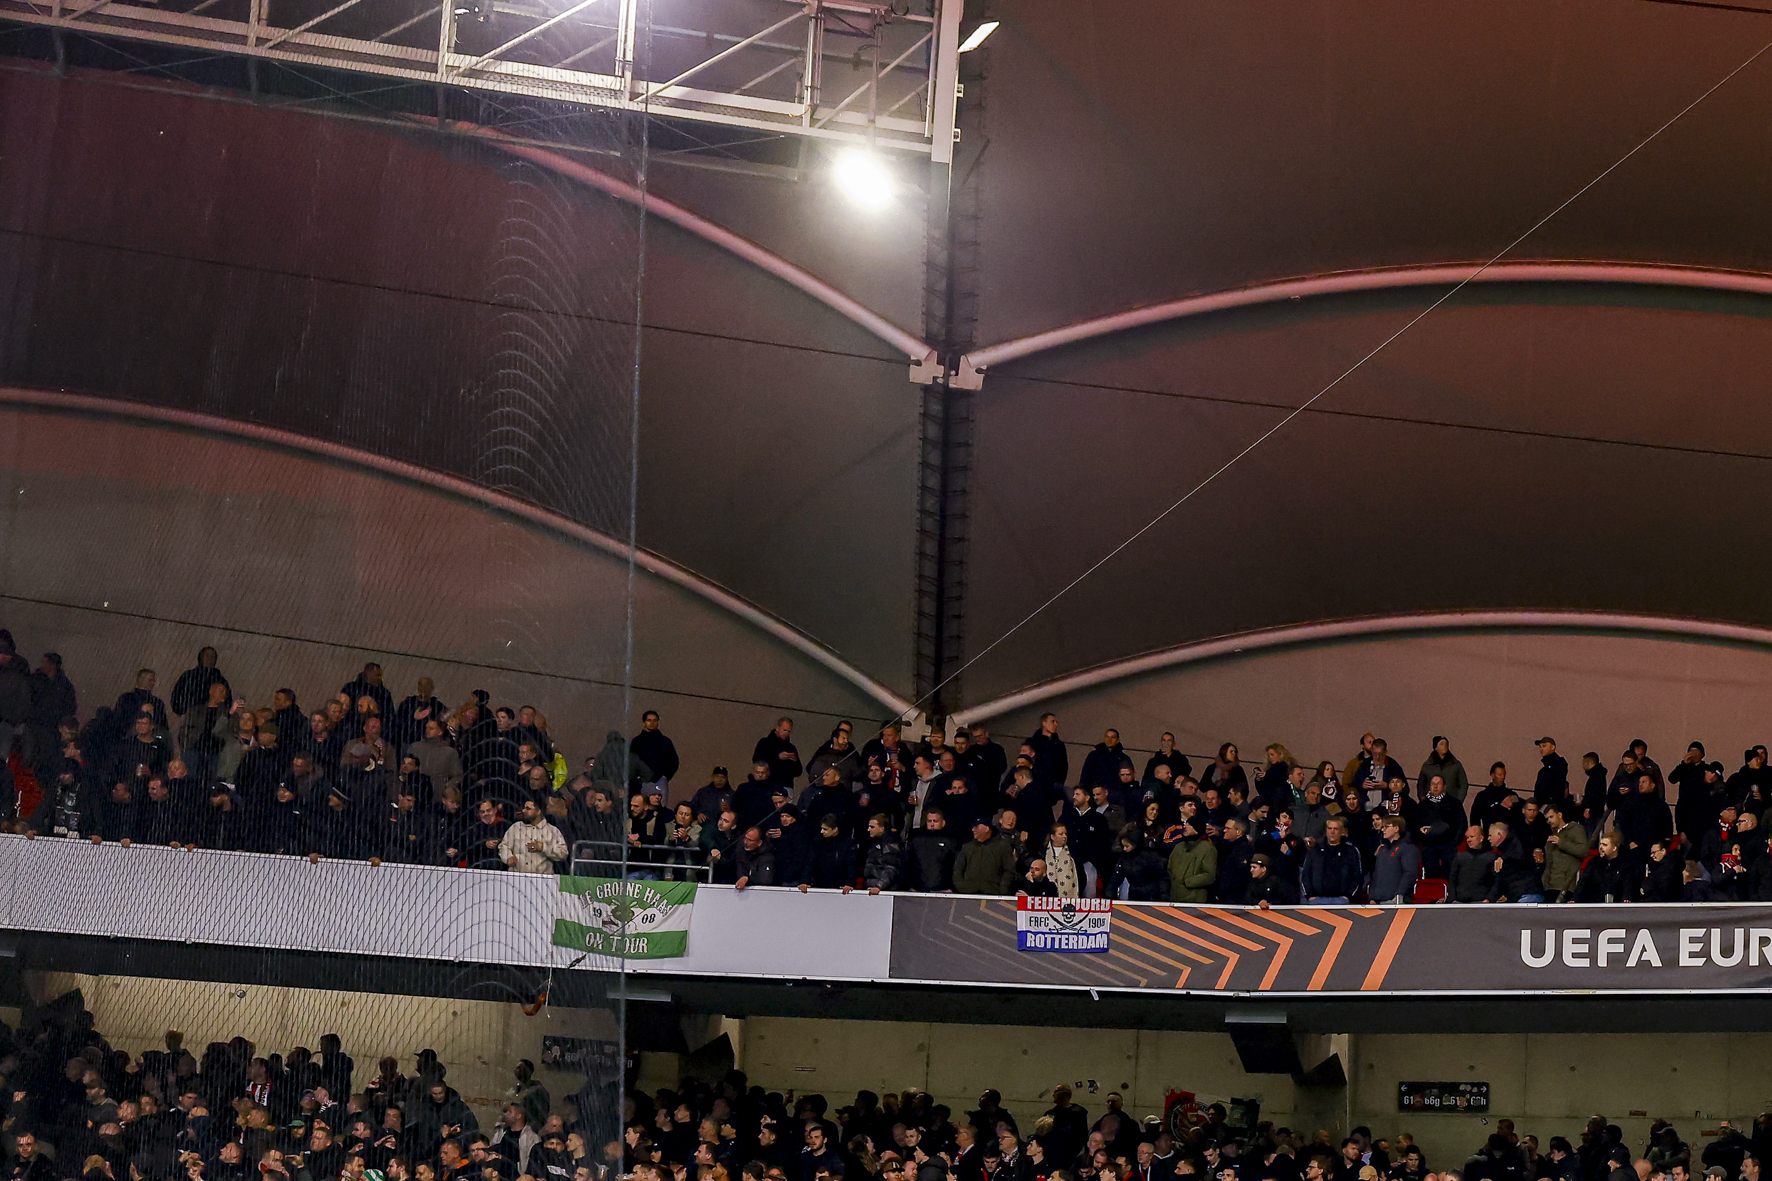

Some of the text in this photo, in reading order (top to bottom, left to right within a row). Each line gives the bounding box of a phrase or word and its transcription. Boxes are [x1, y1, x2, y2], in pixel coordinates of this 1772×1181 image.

[641, 913, 656, 924] 08
[585, 932, 605, 950] ON
[1026, 932, 1108, 950] ROTTERDAM
[1520, 928, 1663, 968] UEFA
